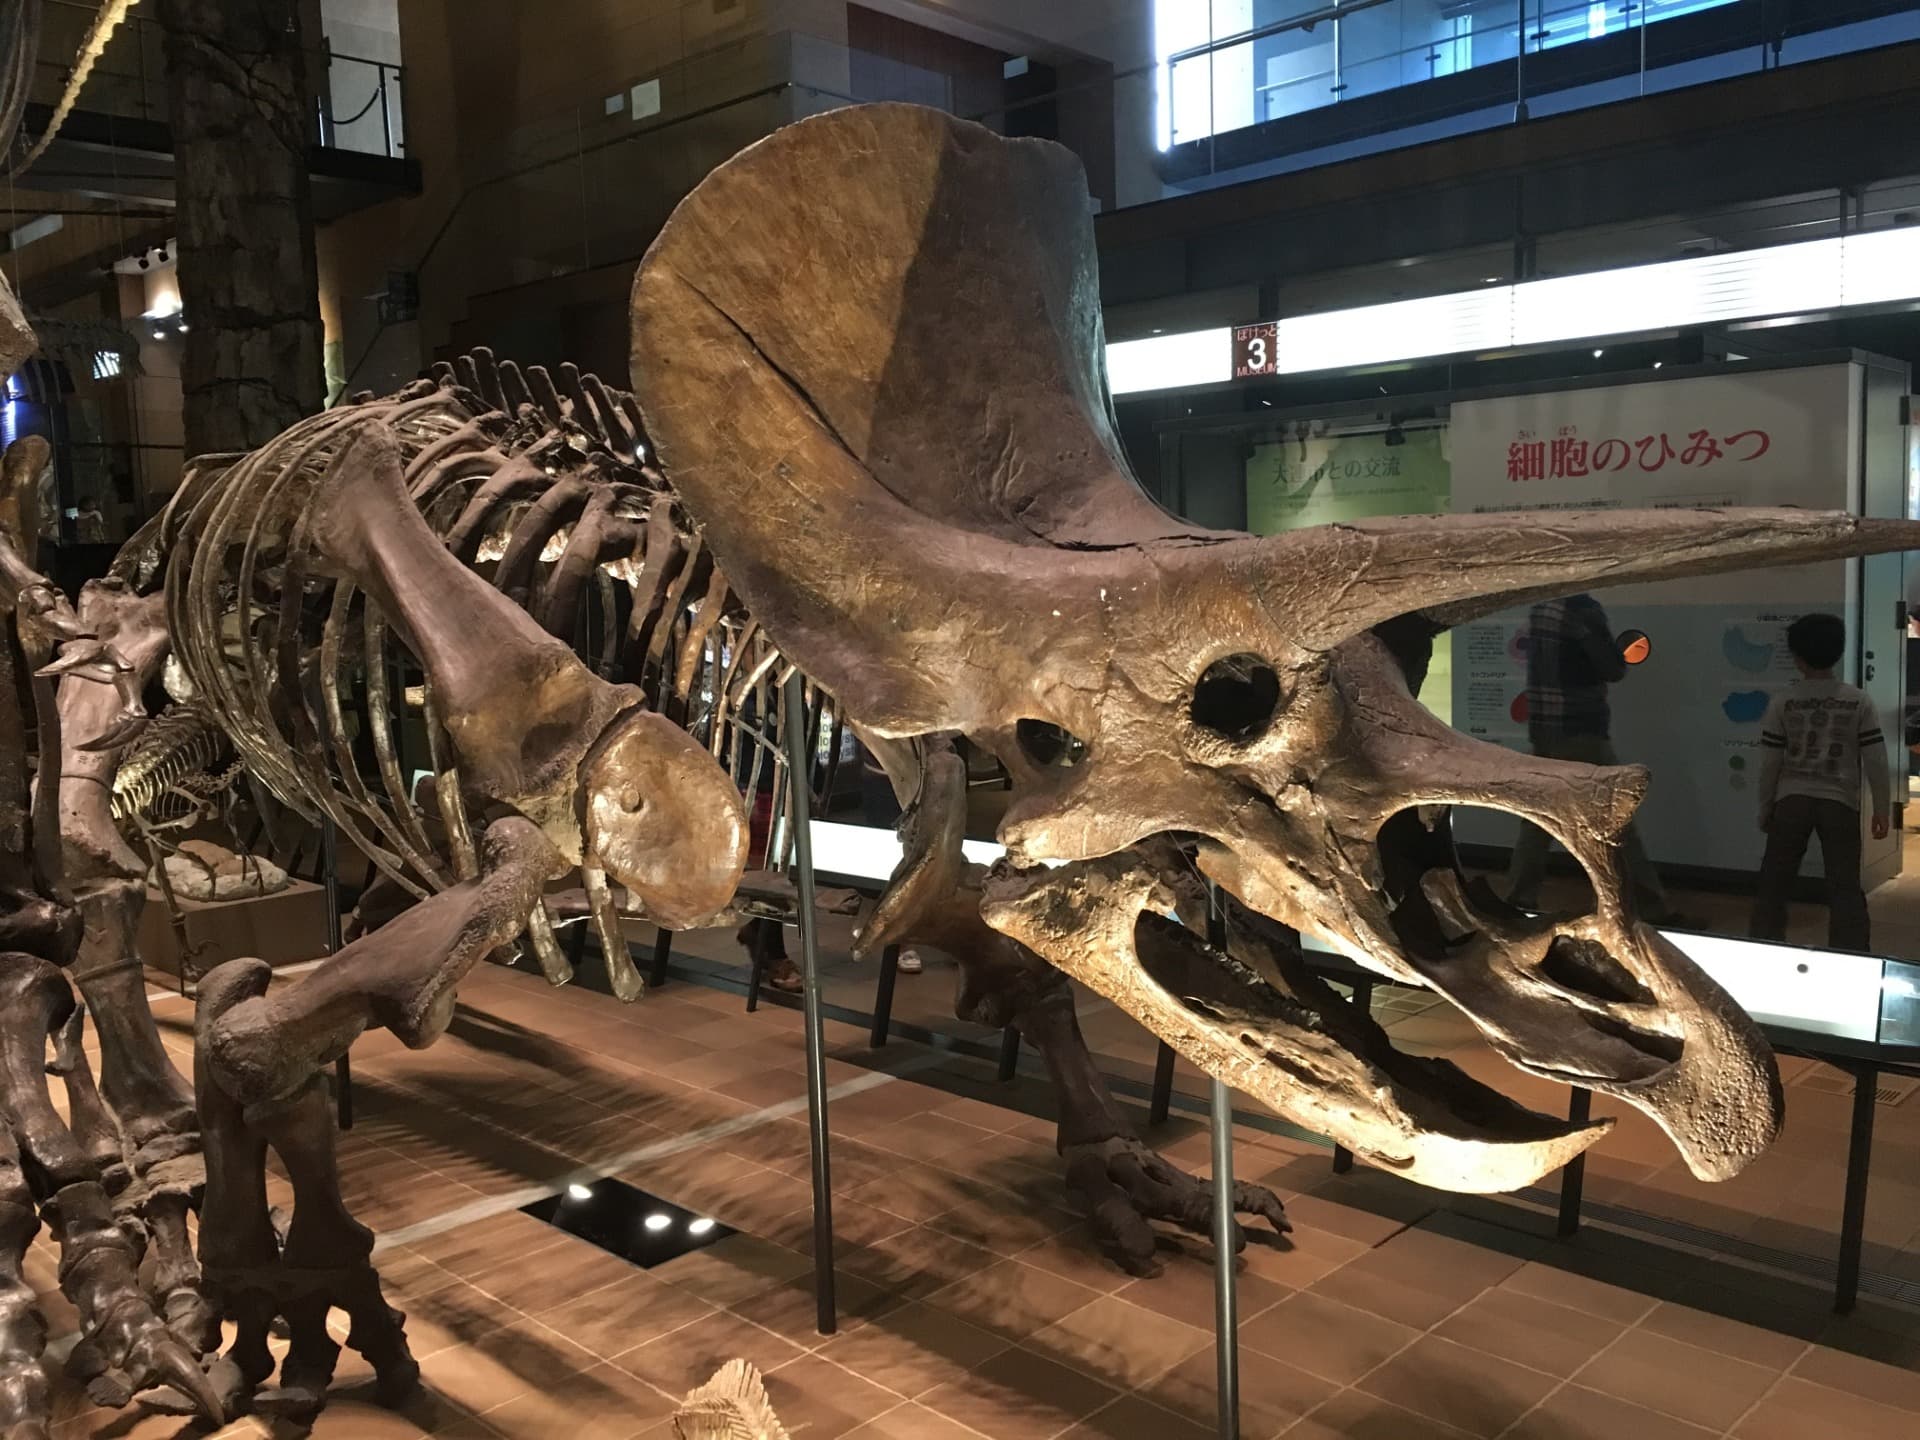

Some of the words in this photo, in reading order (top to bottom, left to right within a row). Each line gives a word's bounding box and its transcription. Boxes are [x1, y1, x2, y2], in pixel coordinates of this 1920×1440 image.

[1247, 338, 1267, 369] 3
[1237, 363, 1276, 376] MUSEUM
[1272, 456, 1401, 484] 大との交流
[1507, 429, 1770, 482] 細胞のひみつ
